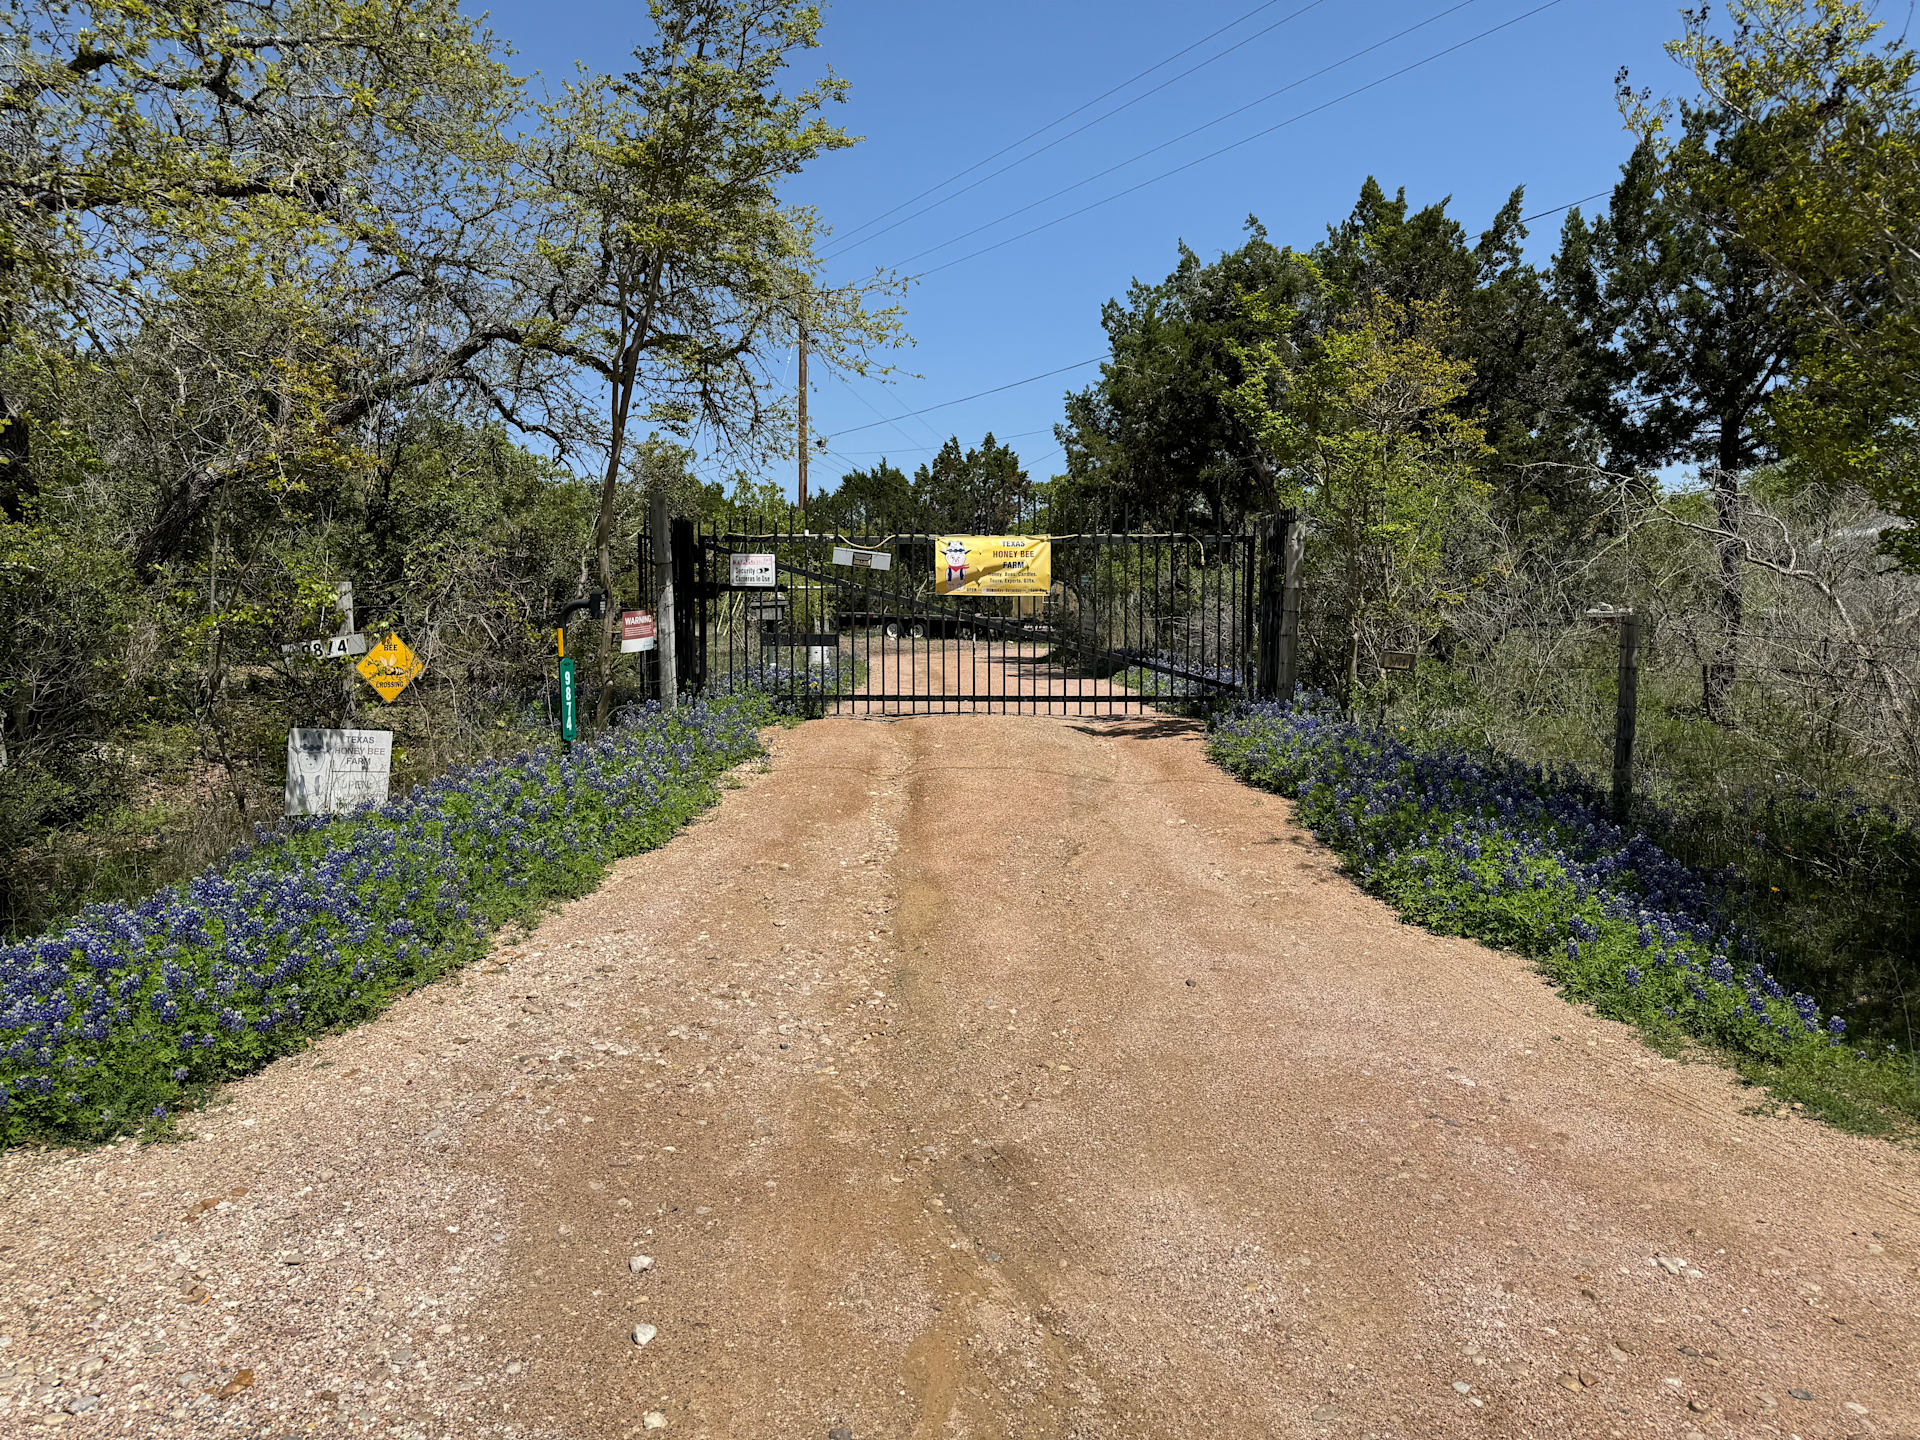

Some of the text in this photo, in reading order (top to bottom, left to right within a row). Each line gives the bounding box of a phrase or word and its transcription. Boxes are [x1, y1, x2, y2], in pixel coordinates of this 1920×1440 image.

[1002, 540, 1025, 548] TEXAS
[992, 550, 1035, 558] HONEY BEE
[1003, 561, 1025, 569] FARM
[735, 567, 755, 575] Security
[624, 614, 652, 626] WARNING
[383, 643, 398, 651] BEE
[375, 681, 404, 689] CROSSING
[564, 671, 573, 731] 9874
[345, 735, 375, 744] TEXAS
[334, 746, 386, 756] HONEY BEE
[346, 757, 371, 765] FARM
